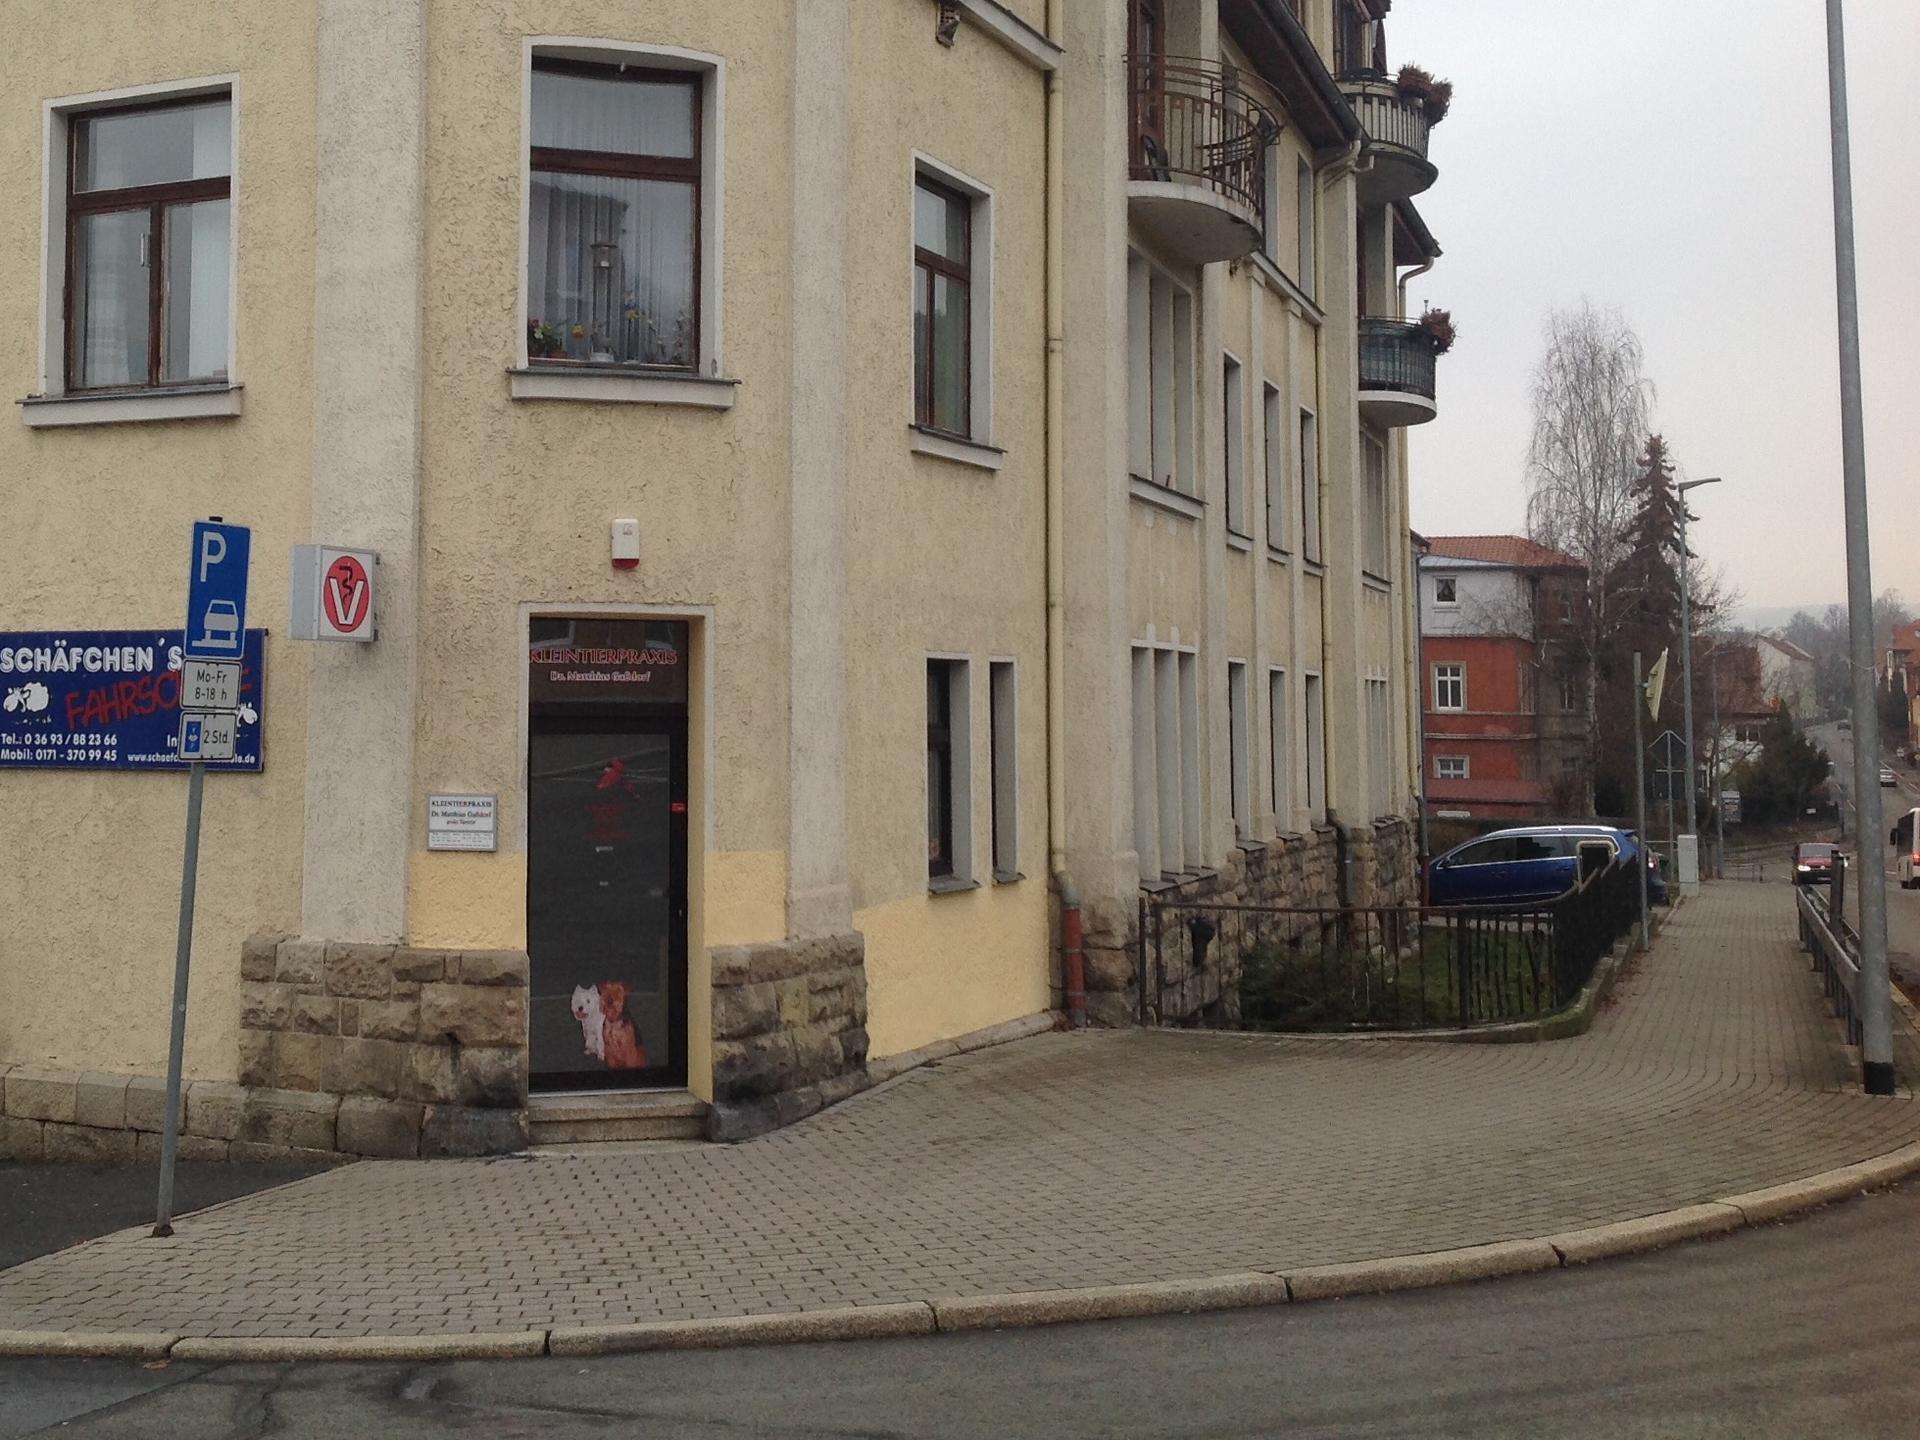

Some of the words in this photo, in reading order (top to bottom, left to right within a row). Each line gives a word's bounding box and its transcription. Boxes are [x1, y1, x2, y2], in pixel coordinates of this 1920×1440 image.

[200, 531, 227, 582] P
[328, 576, 365, 625] V
[0, 639, 154, 673] SCHÄFCHEN
[530, 648, 678, 664] KLEINTIERPRAXIS
[196, 669, 228, 683] Mo-Fr
[550, 670, 566, 682] Dr.
[567, 670, 611, 682] Matthias
[195, 687, 216, 700] 8-18
[221, 688, 228, 700] h
[1, 733, 22, 745] Tel.:
[24, 733, 32, 745] 0
[34, 733, 48, 745] 36
[50, 733, 63, 745] 93
[64, 733, 71, 745] /
[73, 733, 86, 745] 88
[88, 733, 101, 746] 23
[103, 733, 118, 746] 66
[203, 730, 210, 744] 2
[0, 749, 33, 761] Mobil:
[35, 749, 57, 761] 0171
[66, 749, 86, 761] 370
[88, 749, 101, 761] 99
[103, 749, 117, 761] 45
[431, 800, 492, 808] KLEINTIERPRAXIS
